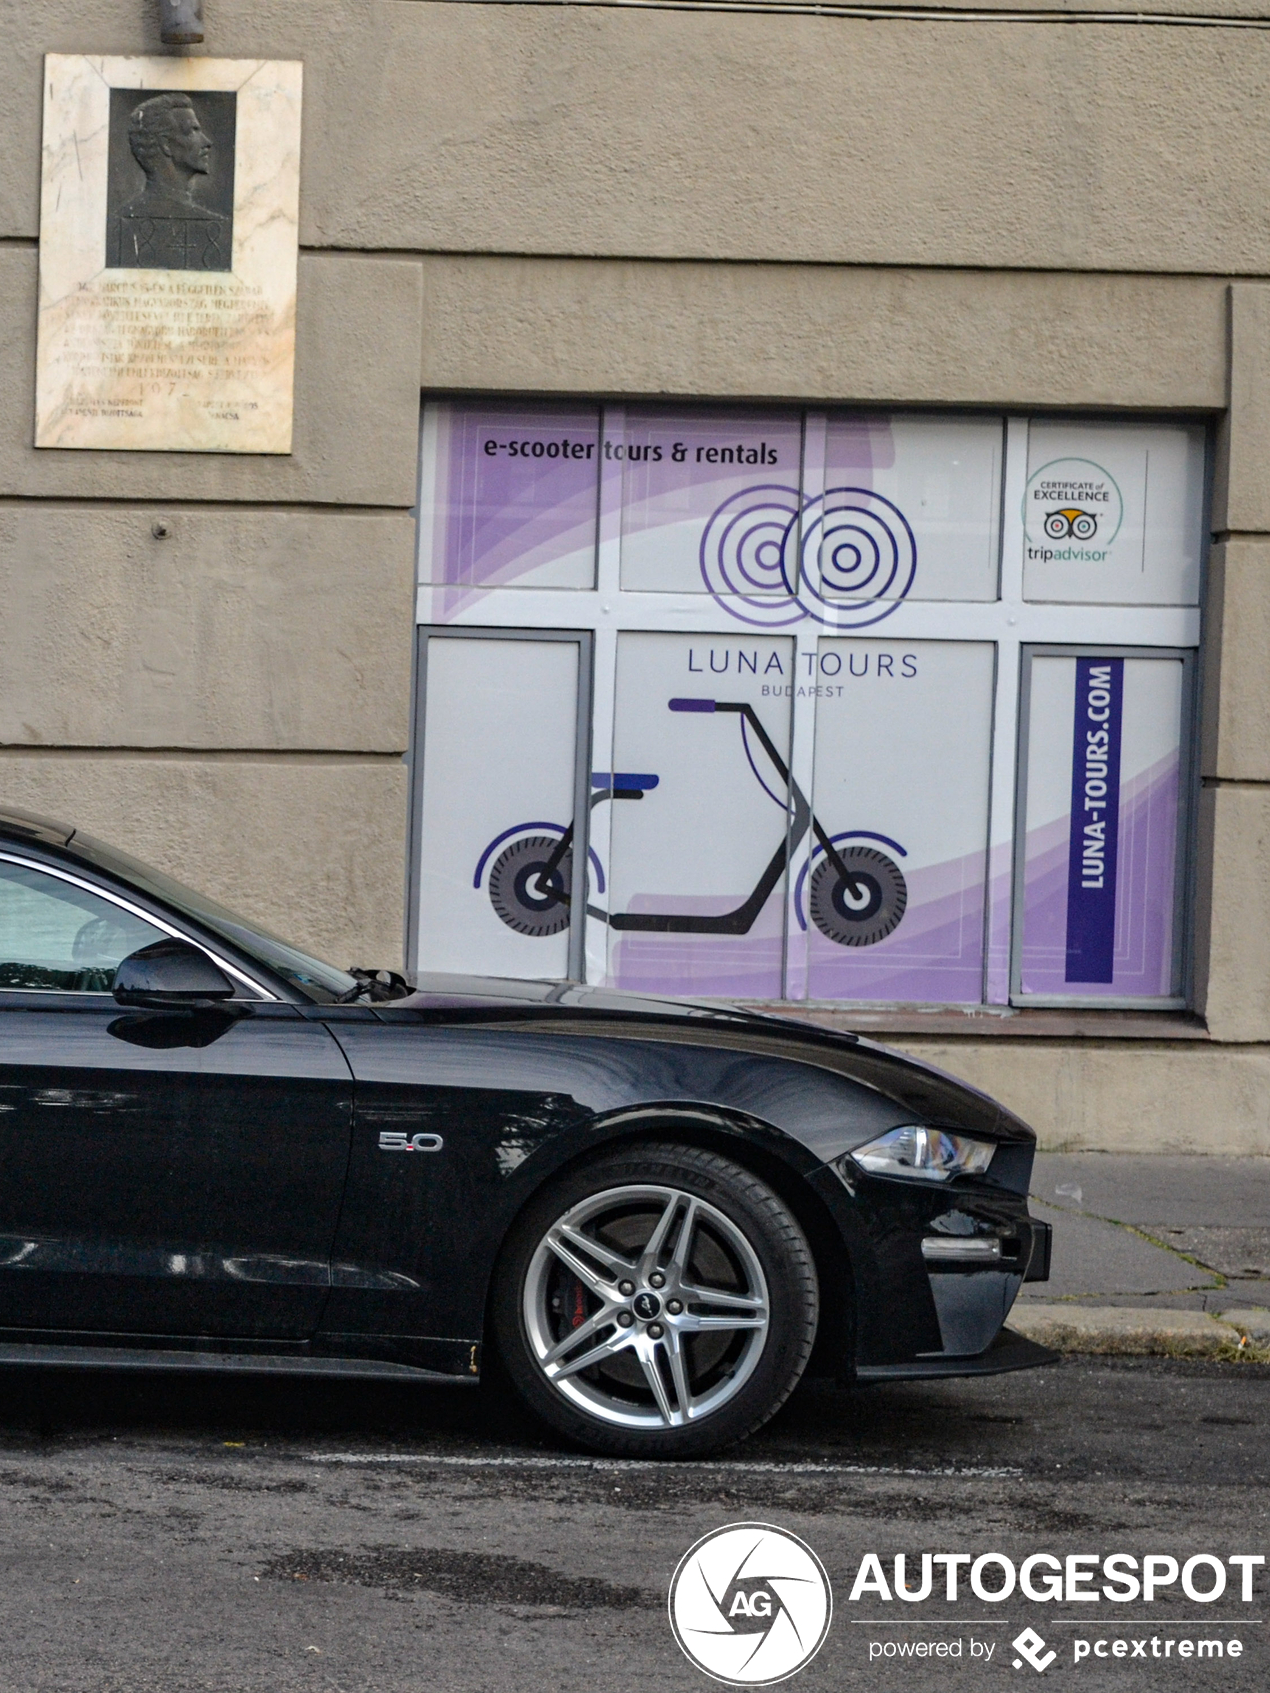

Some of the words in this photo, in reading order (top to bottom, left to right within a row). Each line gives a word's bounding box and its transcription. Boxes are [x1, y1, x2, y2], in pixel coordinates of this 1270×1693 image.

[483, 438, 594, 460] e-scooter
[604, 440, 663, 462] tours
[671, 442, 687, 463] &
[695, 442, 778, 465] rentals
[1040, 481, 1094, 491] CERTIFICATE
[1095, 482, 1105, 490] of
[1033, 490, 1110, 502] EXCELLENCE
[1028, 546, 1108, 563] tripadvisor
[688, 649, 784, 675] LUNA
[801, 652, 918, 678] TOURS
[761, 684, 845, 698] BUDAPEST
[1081, 665, 1112, 889] LUNA-TOURS.COM
[377, 1131, 444, 1152] 5.0
